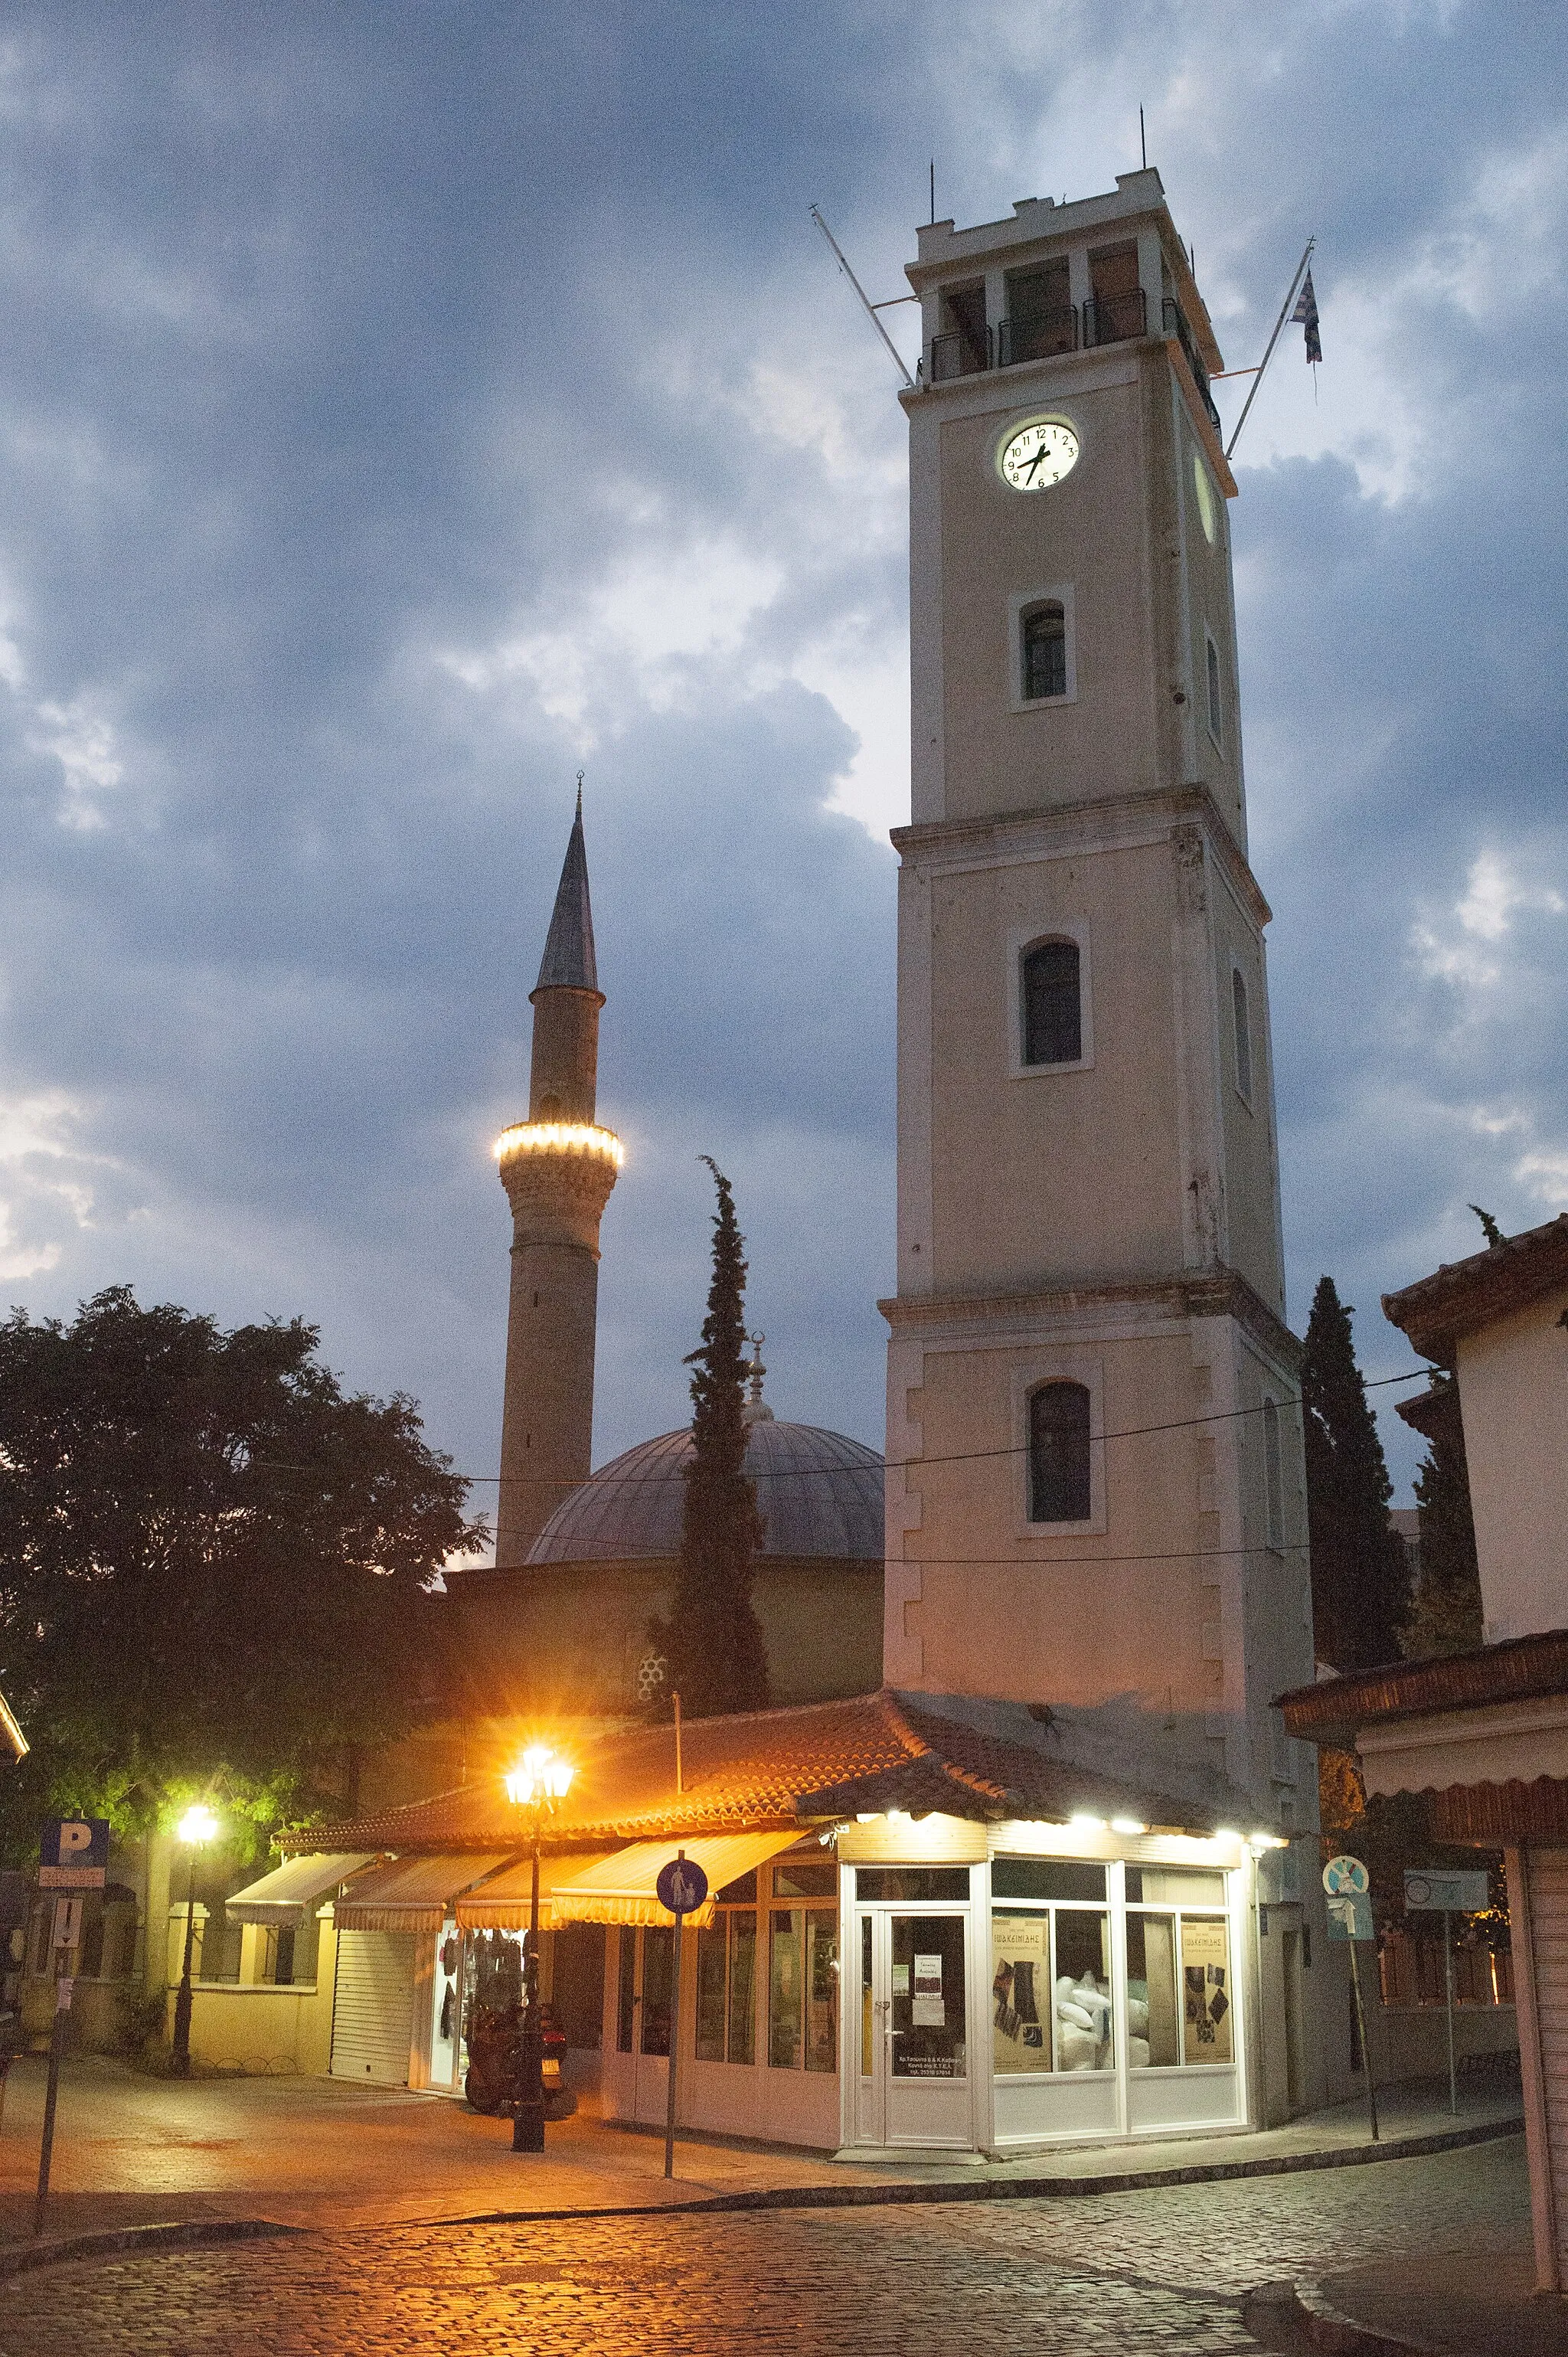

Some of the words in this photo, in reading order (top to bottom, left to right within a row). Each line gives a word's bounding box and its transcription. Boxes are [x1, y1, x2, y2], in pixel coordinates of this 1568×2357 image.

[1036, 429, 1046, 439] 12
[1053, 430, 1057, 439] 1
[1023, 436, 1030, 446] 11
[1062, 436, 1069, 445] 2
[1011, 447, 1021, 457] 10
[1068, 447, 1074, 457] 3
[1008, 461, 1014, 470] 9
[1012, 472, 1019, 482] 8
[1053, 472, 1059, 482] 5
[1038, 478, 1045, 488] 6
[58, 1823, 92, 1865] P
